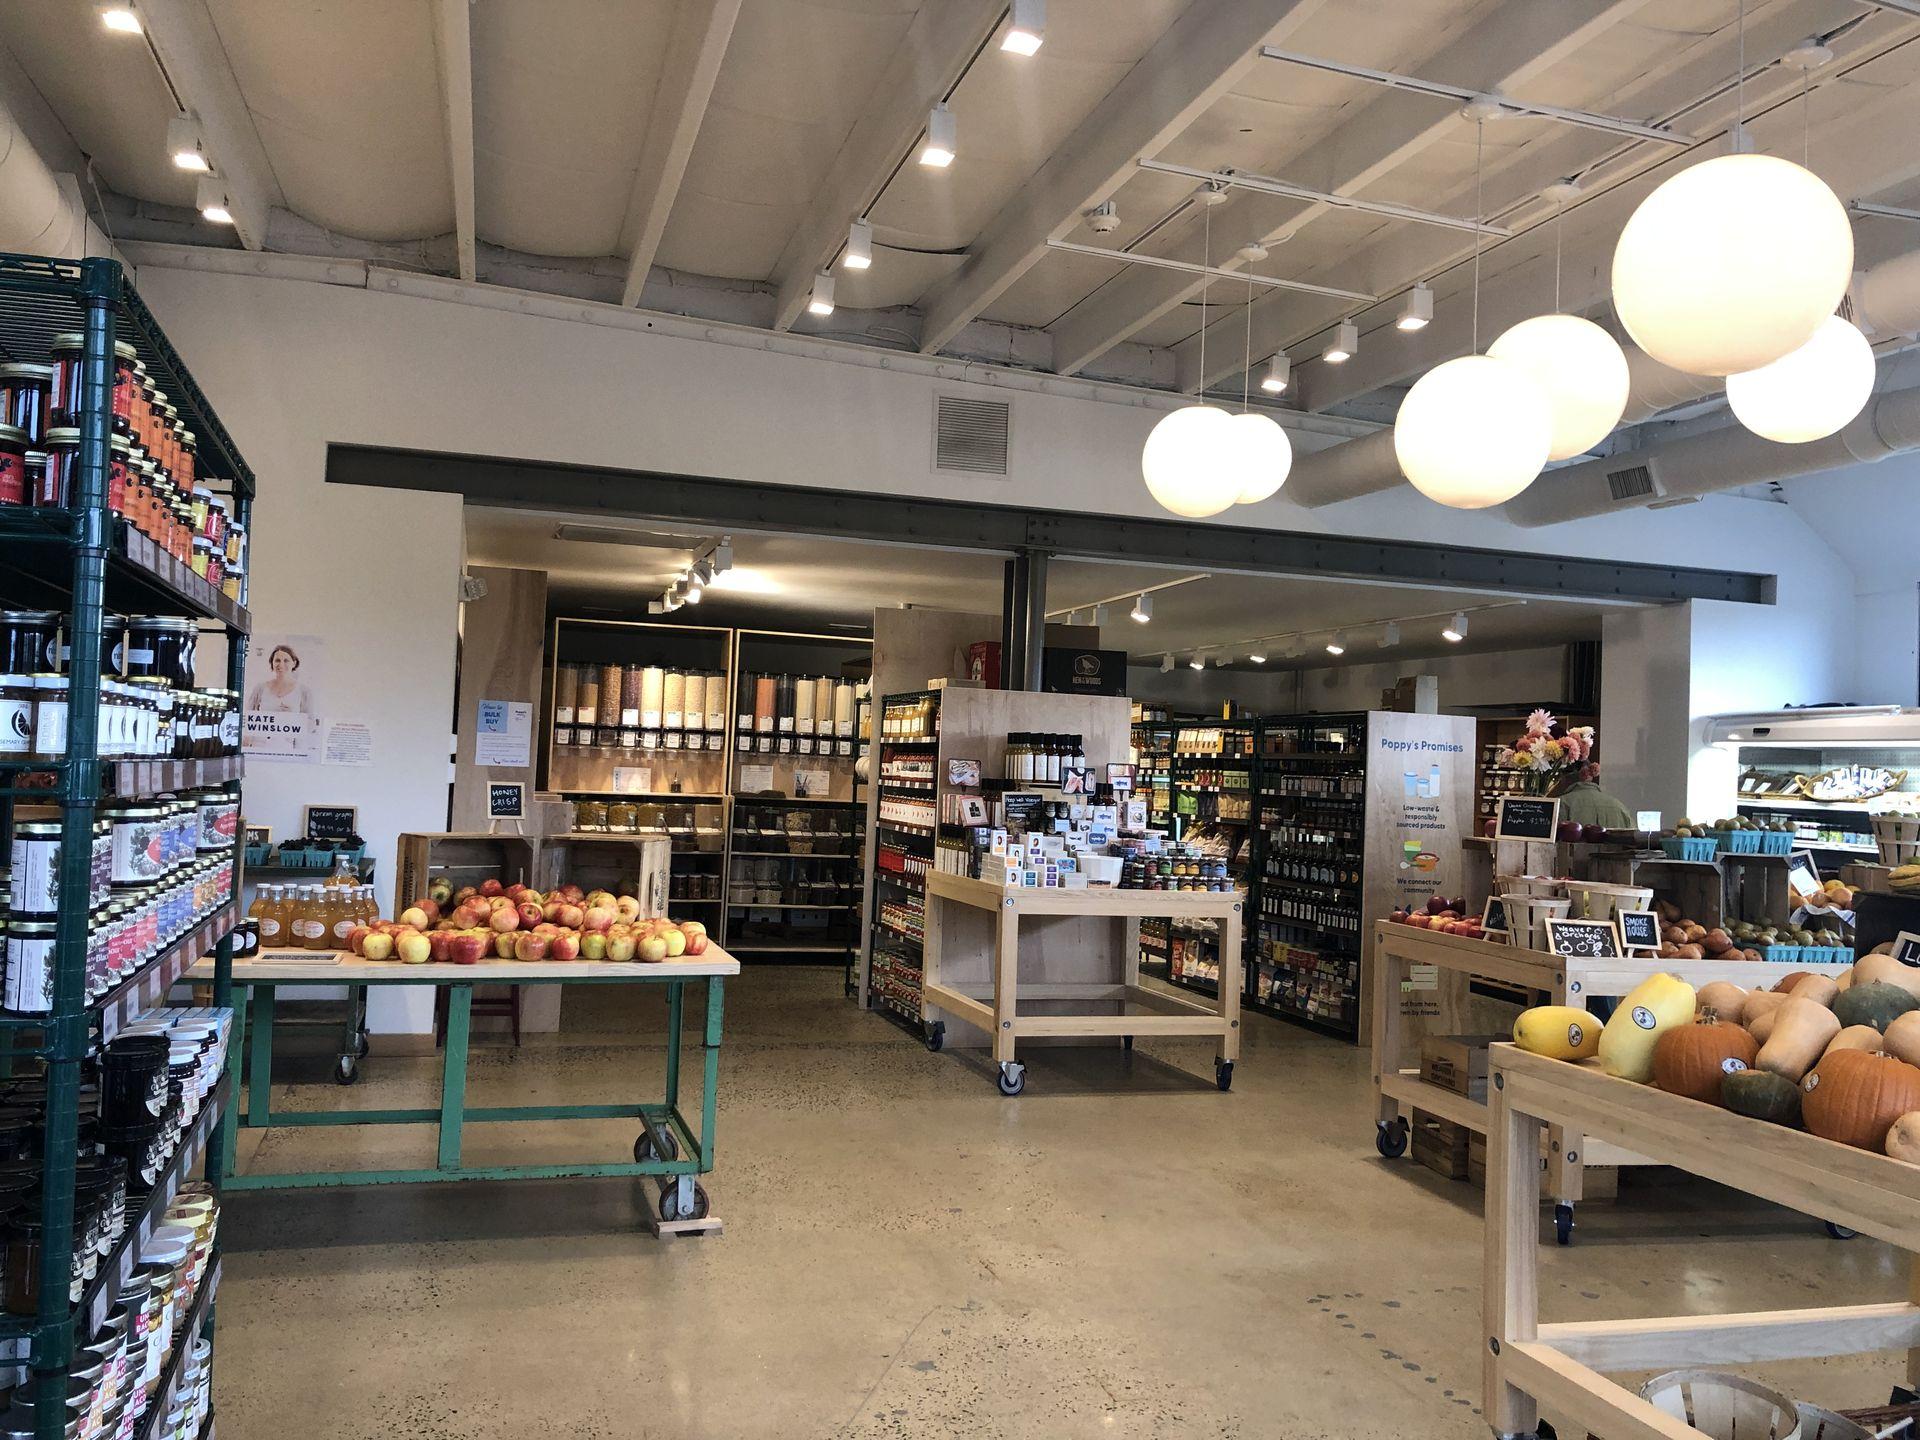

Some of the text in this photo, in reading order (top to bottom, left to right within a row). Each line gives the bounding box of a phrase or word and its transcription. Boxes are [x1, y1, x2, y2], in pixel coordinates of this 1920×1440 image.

[247, 714, 275, 723] KATE
[247, 723, 301, 733] WINSLOW
[1381, 738, 1464, 753] Poppy's Promises
[491, 788, 518, 797] HONEY
[491, 796, 518, 807] CRISP
[1402, 804, 1434, 812] Low-waste
[1404, 813, 1438, 821] responsibly
[1625, 917, 1648, 927] SMOKE
[1557, 924, 1592, 933] Weaver
[1626, 926, 1649, 937] HOUSE
[1561, 931, 1601, 940] Orchards
